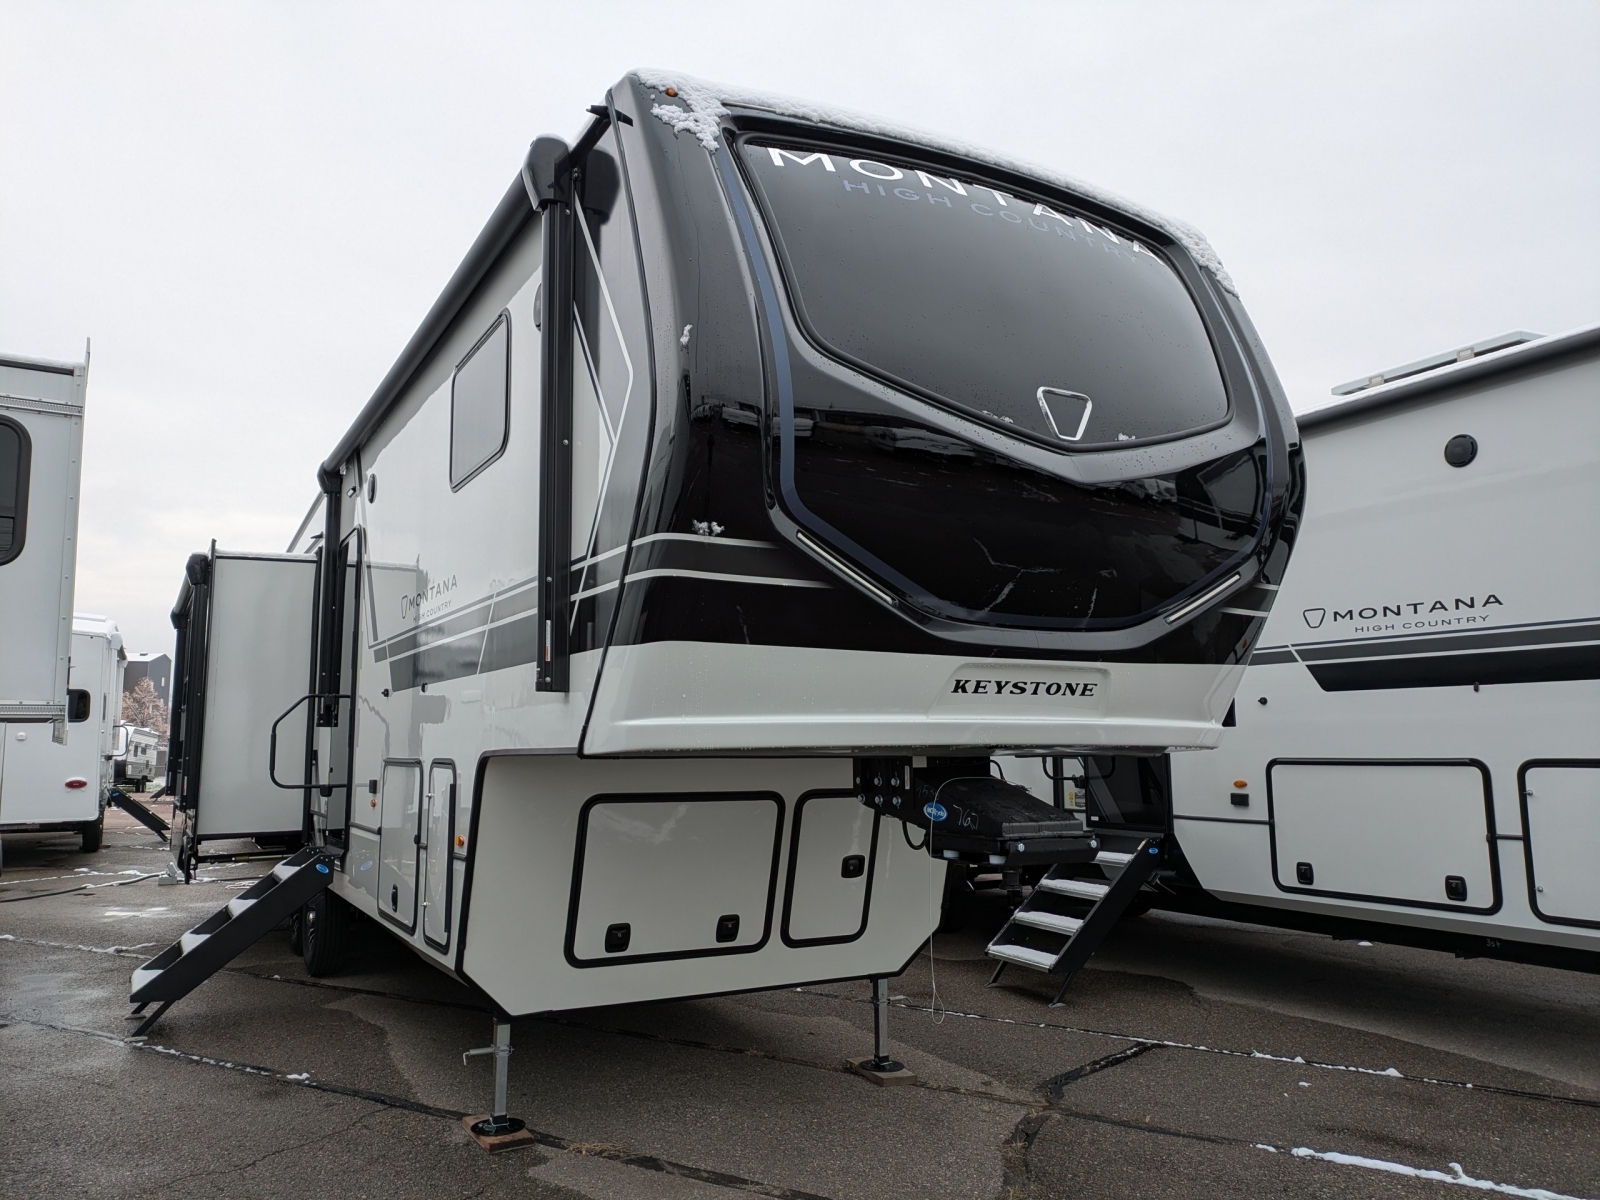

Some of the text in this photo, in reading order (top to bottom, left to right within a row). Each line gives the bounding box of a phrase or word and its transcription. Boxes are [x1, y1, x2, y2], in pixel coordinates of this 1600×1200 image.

[766, 147, 1165, 265] MONTANA
[843, 179, 1138, 263] HIGH COUNTRY
[408, 574, 458, 611] MONTANA
[413, 599, 452, 623] HGH COUNTRY
[1333, 594, 1504, 622] MONTANA
[1354, 614, 1490, 633] HIGH COUNTRY
[950, 679, 1098, 697] KEYSTONE
